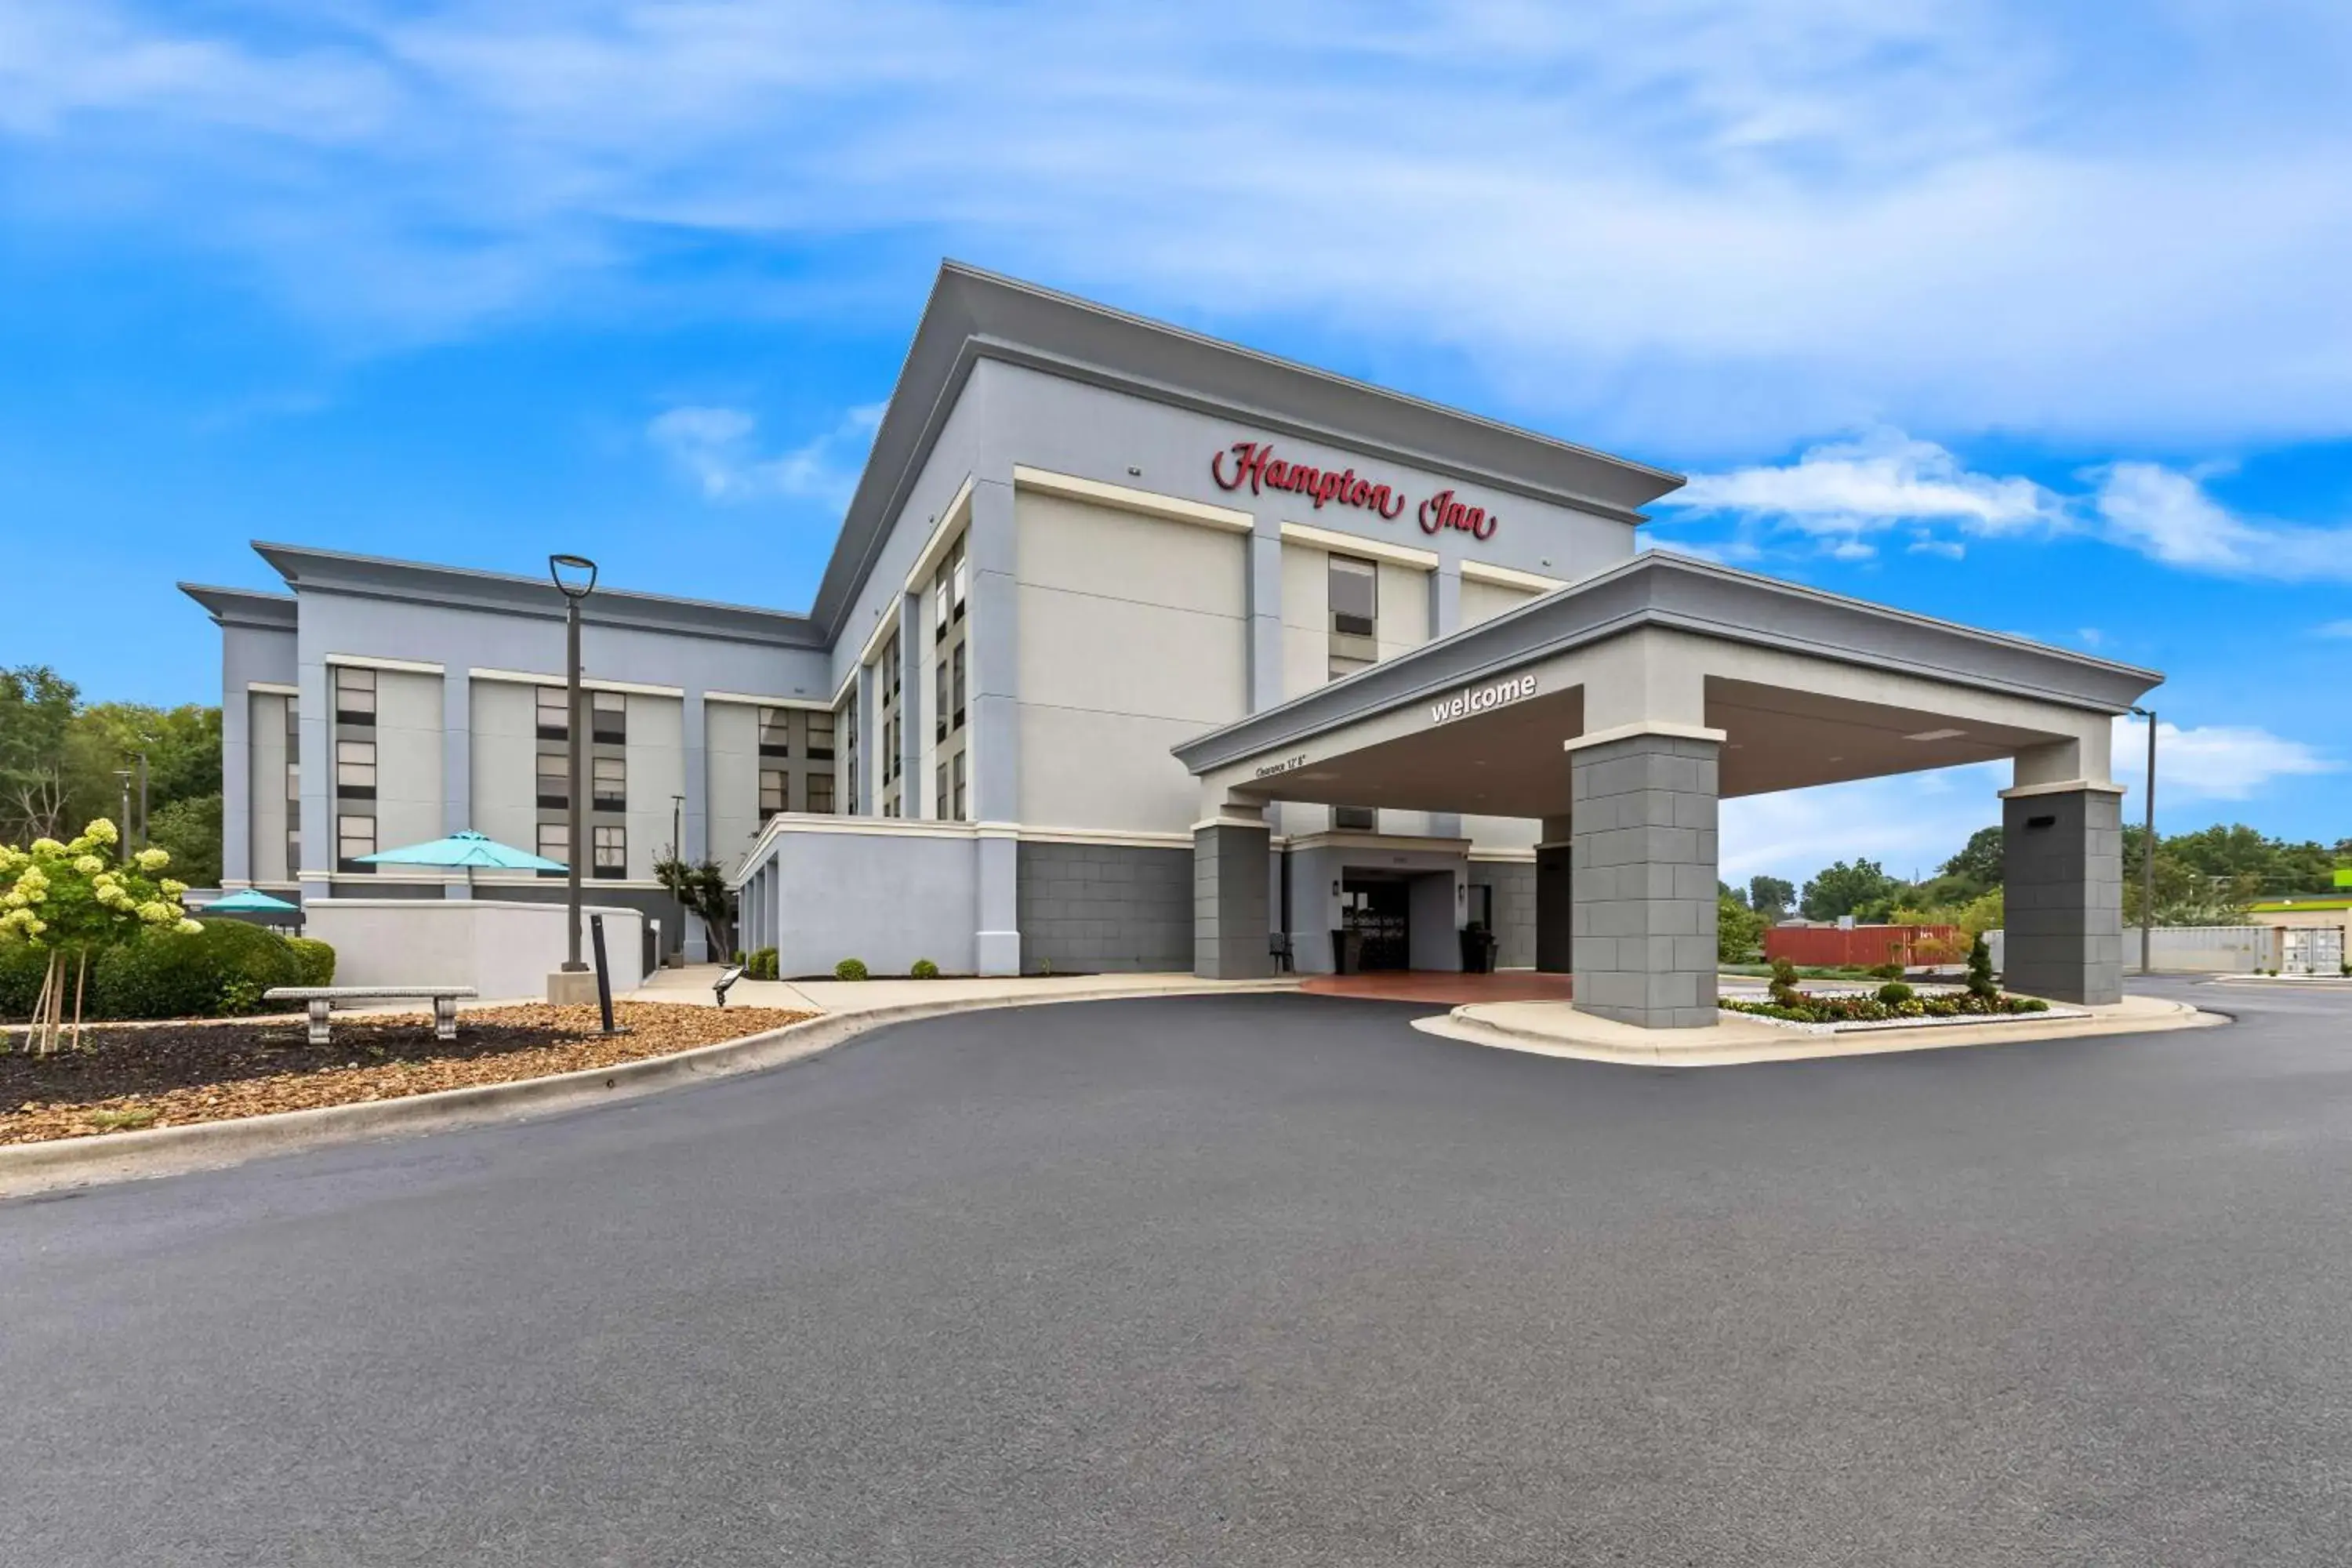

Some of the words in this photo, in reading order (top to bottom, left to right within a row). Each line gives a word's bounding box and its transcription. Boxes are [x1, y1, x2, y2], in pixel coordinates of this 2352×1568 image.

[1212, 442, 1405, 519] Hampton
[1419, 489, 1497, 540] Inn
[1432, 674, 1537, 723] welcome
